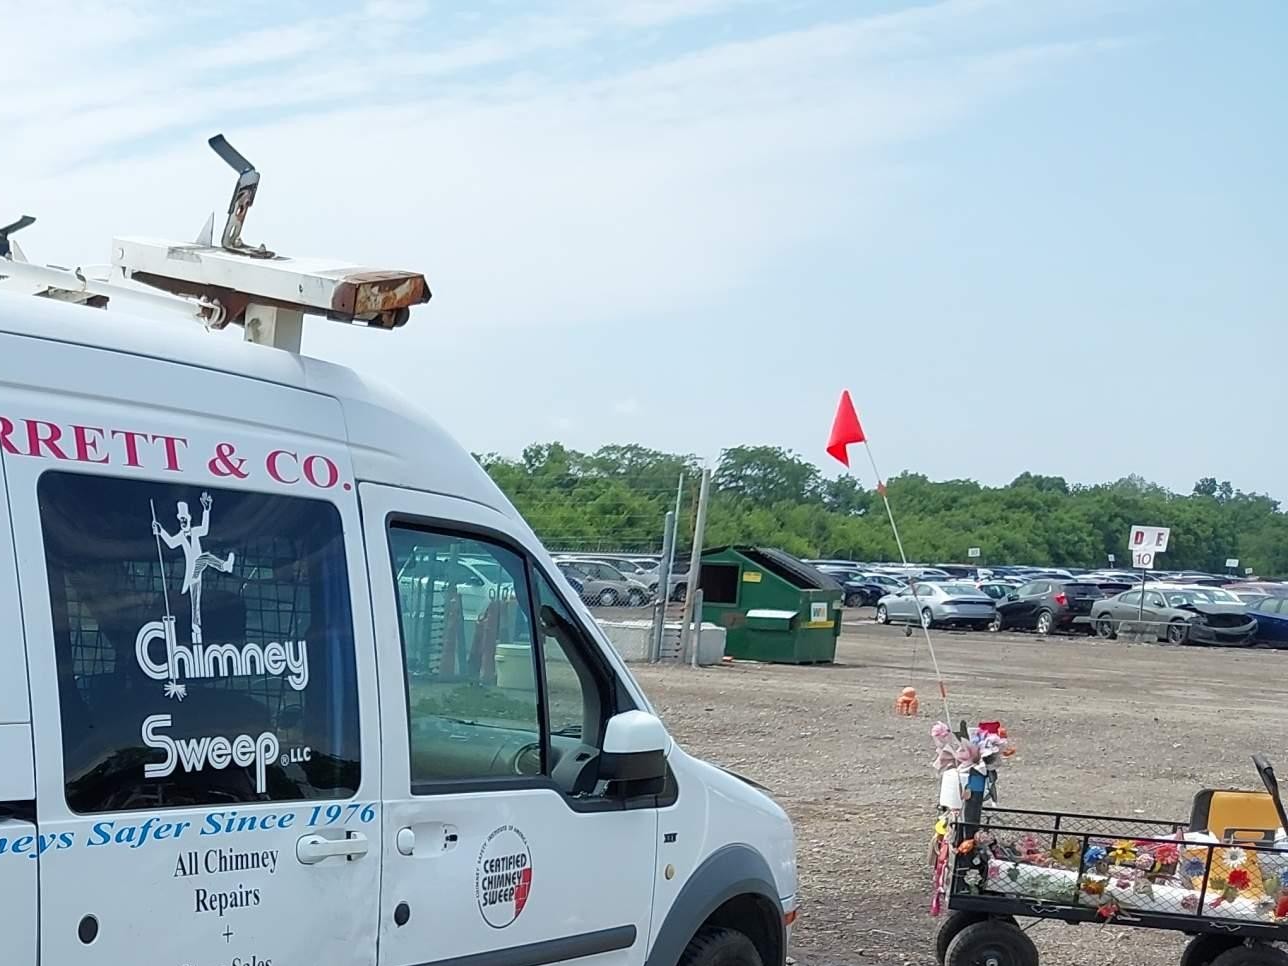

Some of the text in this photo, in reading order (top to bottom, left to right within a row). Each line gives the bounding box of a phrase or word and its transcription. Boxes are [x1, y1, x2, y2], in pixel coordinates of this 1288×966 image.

[208, 442, 250, 479] &
[266, 449, 352, 491] CO.
[1134, 531, 1164, 547] D E
[1136, 553, 1152, 566] 10
[135, 616, 309, 691] Chimney
[142, 714, 312, 793] Sweep LLC
[86, 817, 191, 849] Safer
[200, 811, 296, 835] Since
[306, 803, 376, 827] 1976
[174, 847, 279, 877] All Chimney
[483, 853, 527, 874] CERTIFIED
[481, 869, 522, 891] CHIMNEY
[195, 884, 260, 917] Repairs
[482, 886, 515, 907] SWEEP
